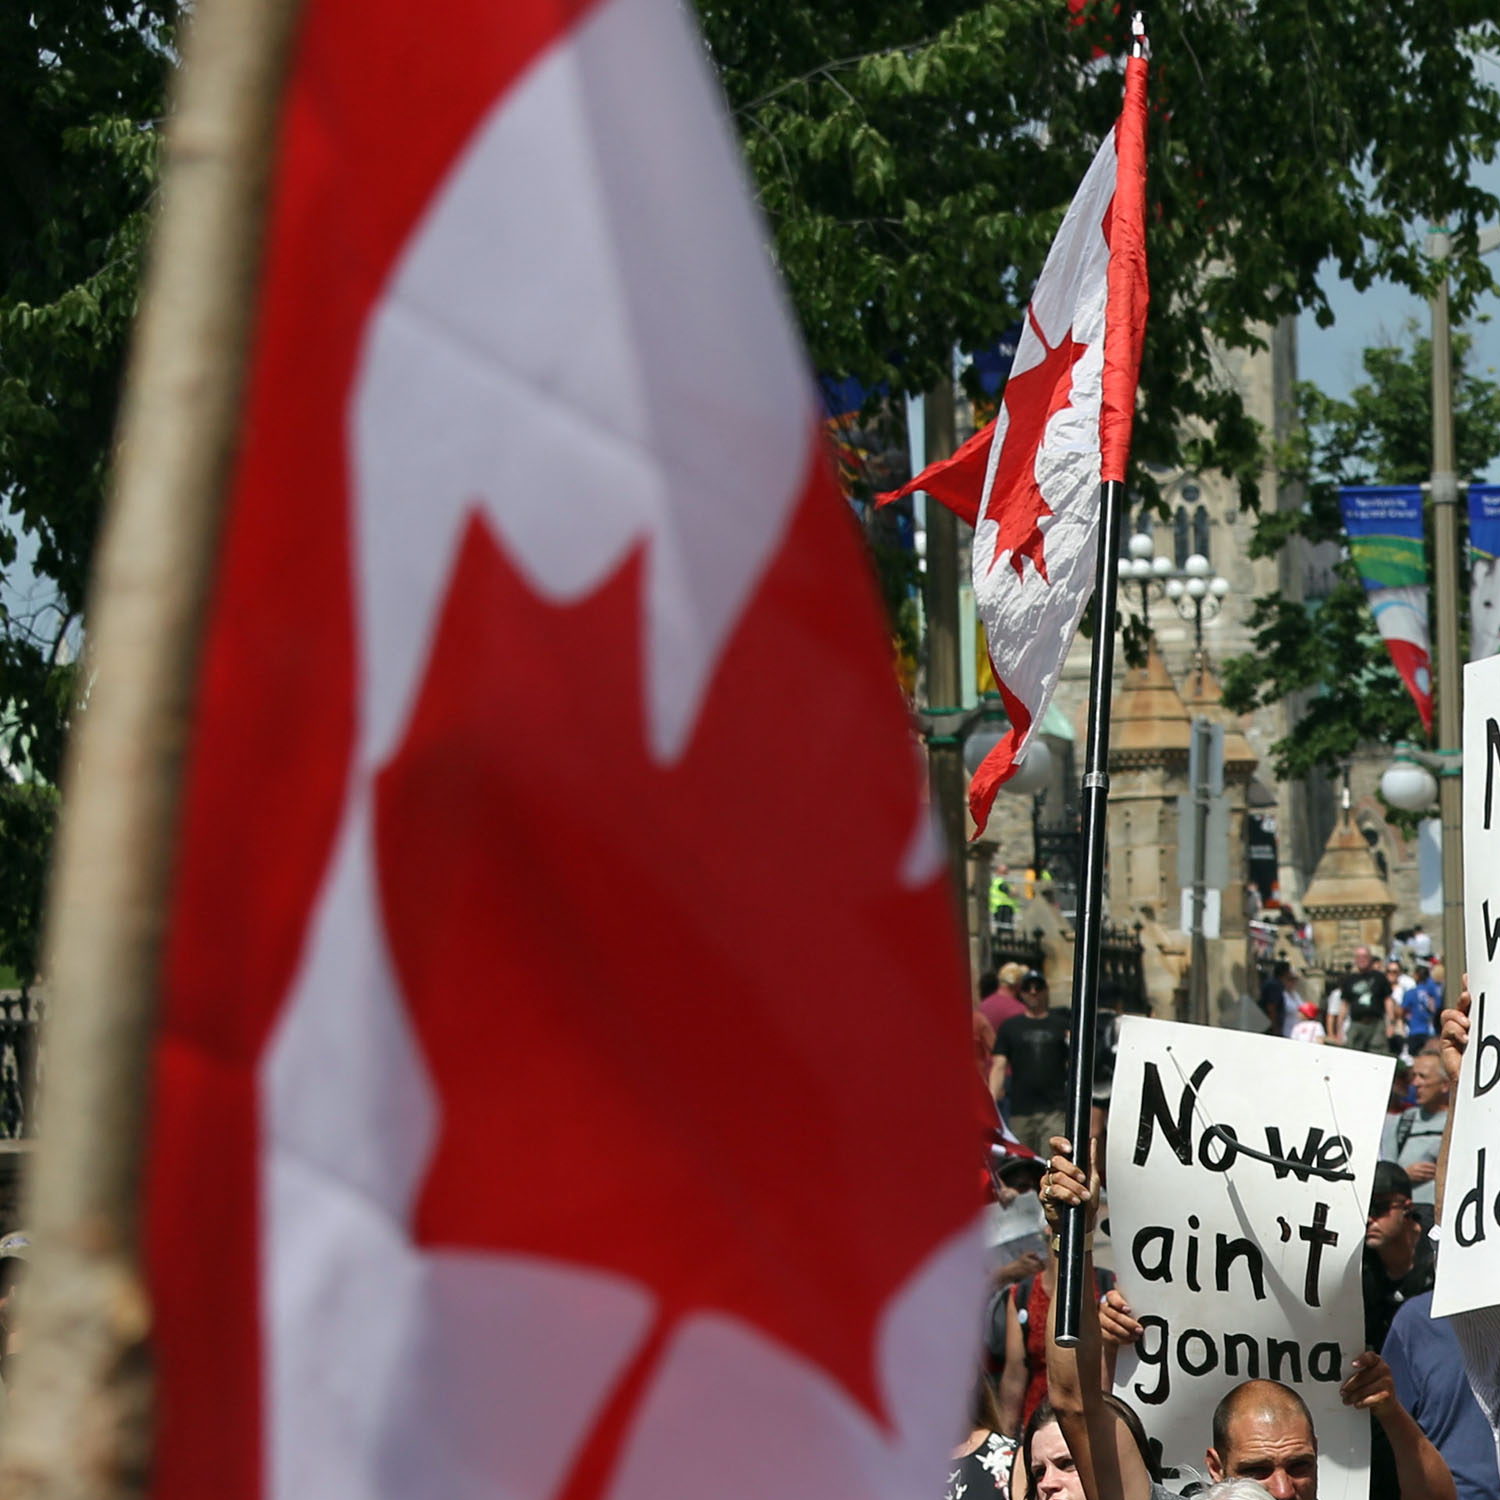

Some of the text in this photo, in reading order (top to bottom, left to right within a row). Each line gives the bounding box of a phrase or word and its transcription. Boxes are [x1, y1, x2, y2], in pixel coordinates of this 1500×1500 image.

[1132, 1058, 1355, 1182] No we
[1131, 1202, 1338, 1308] ain't
[1134, 1314, 1342, 1405] gonna
